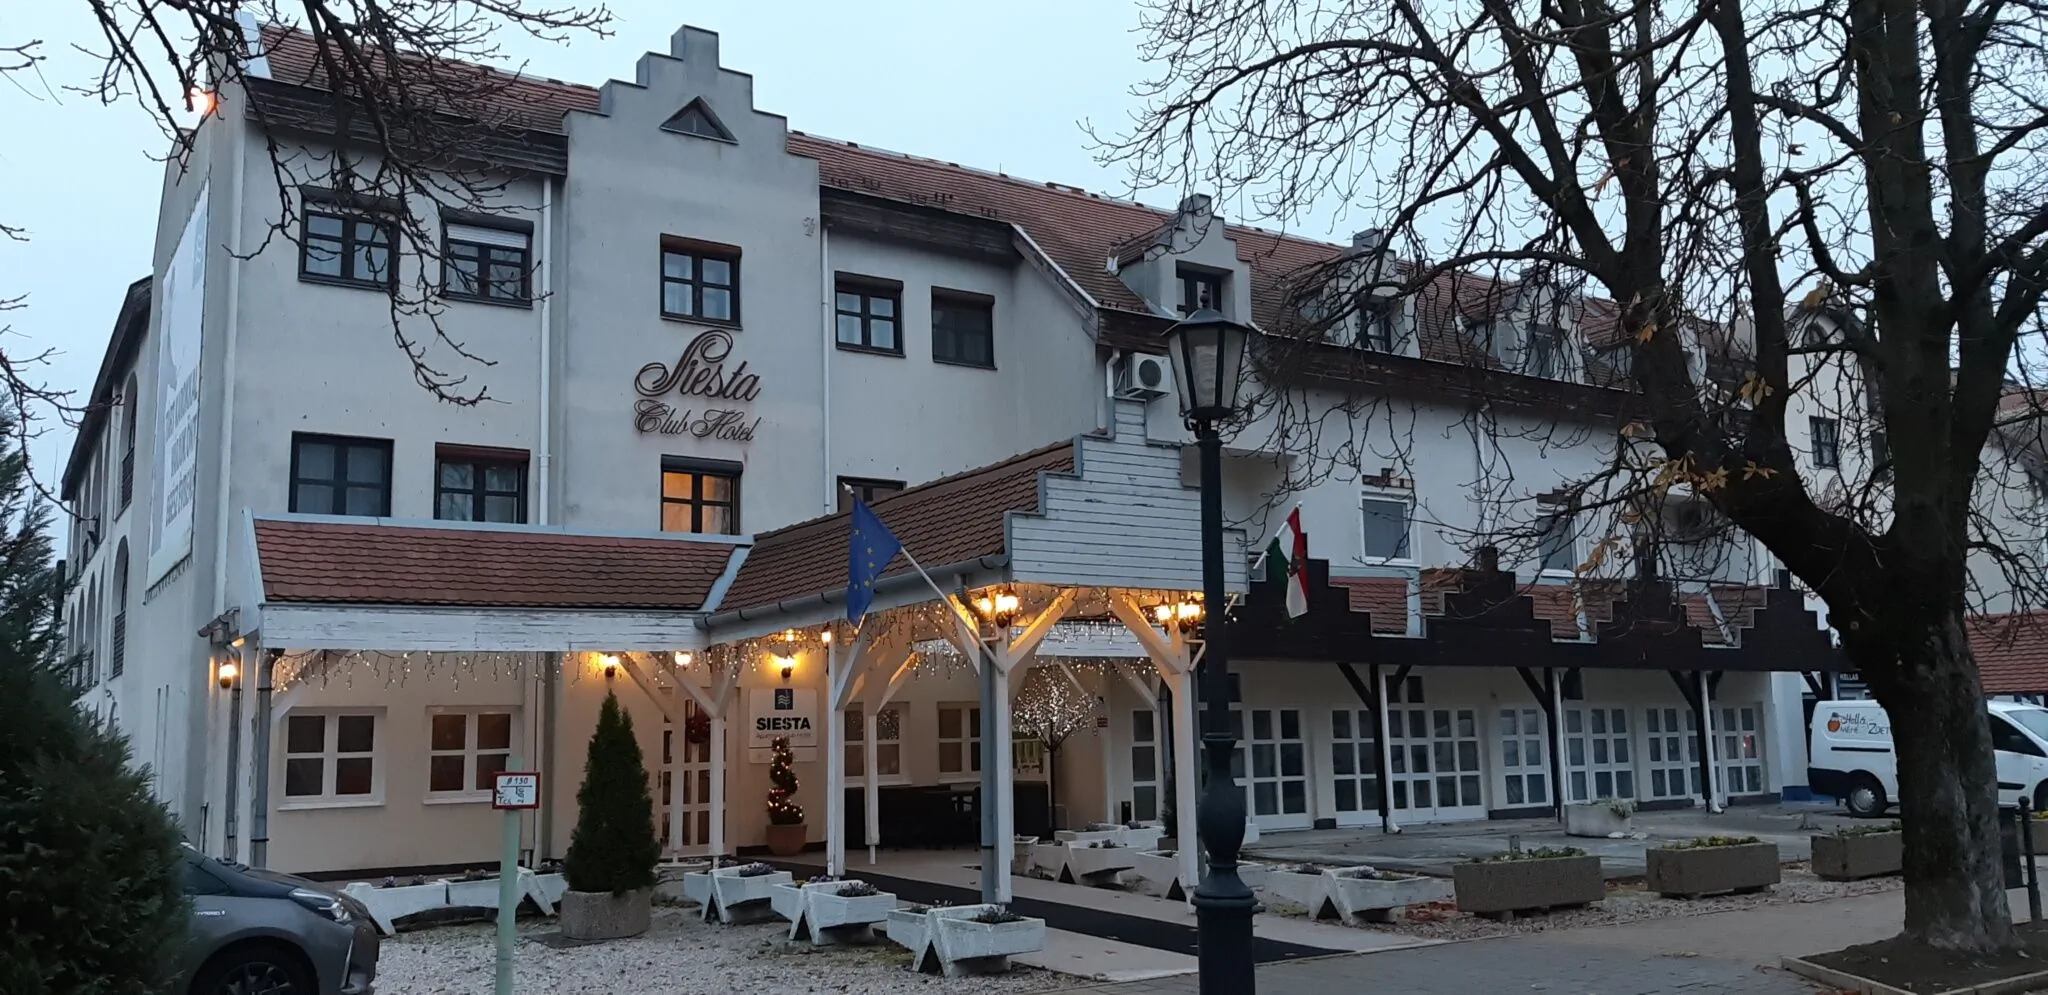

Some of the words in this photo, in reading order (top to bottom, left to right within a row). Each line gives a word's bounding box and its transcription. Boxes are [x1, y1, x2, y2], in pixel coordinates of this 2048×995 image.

[634, 329, 762, 402] Siesta
[633, 399, 690, 435] Club
[690, 408, 762, 442] Hotel
[756, 716, 812, 731] SIESTA
